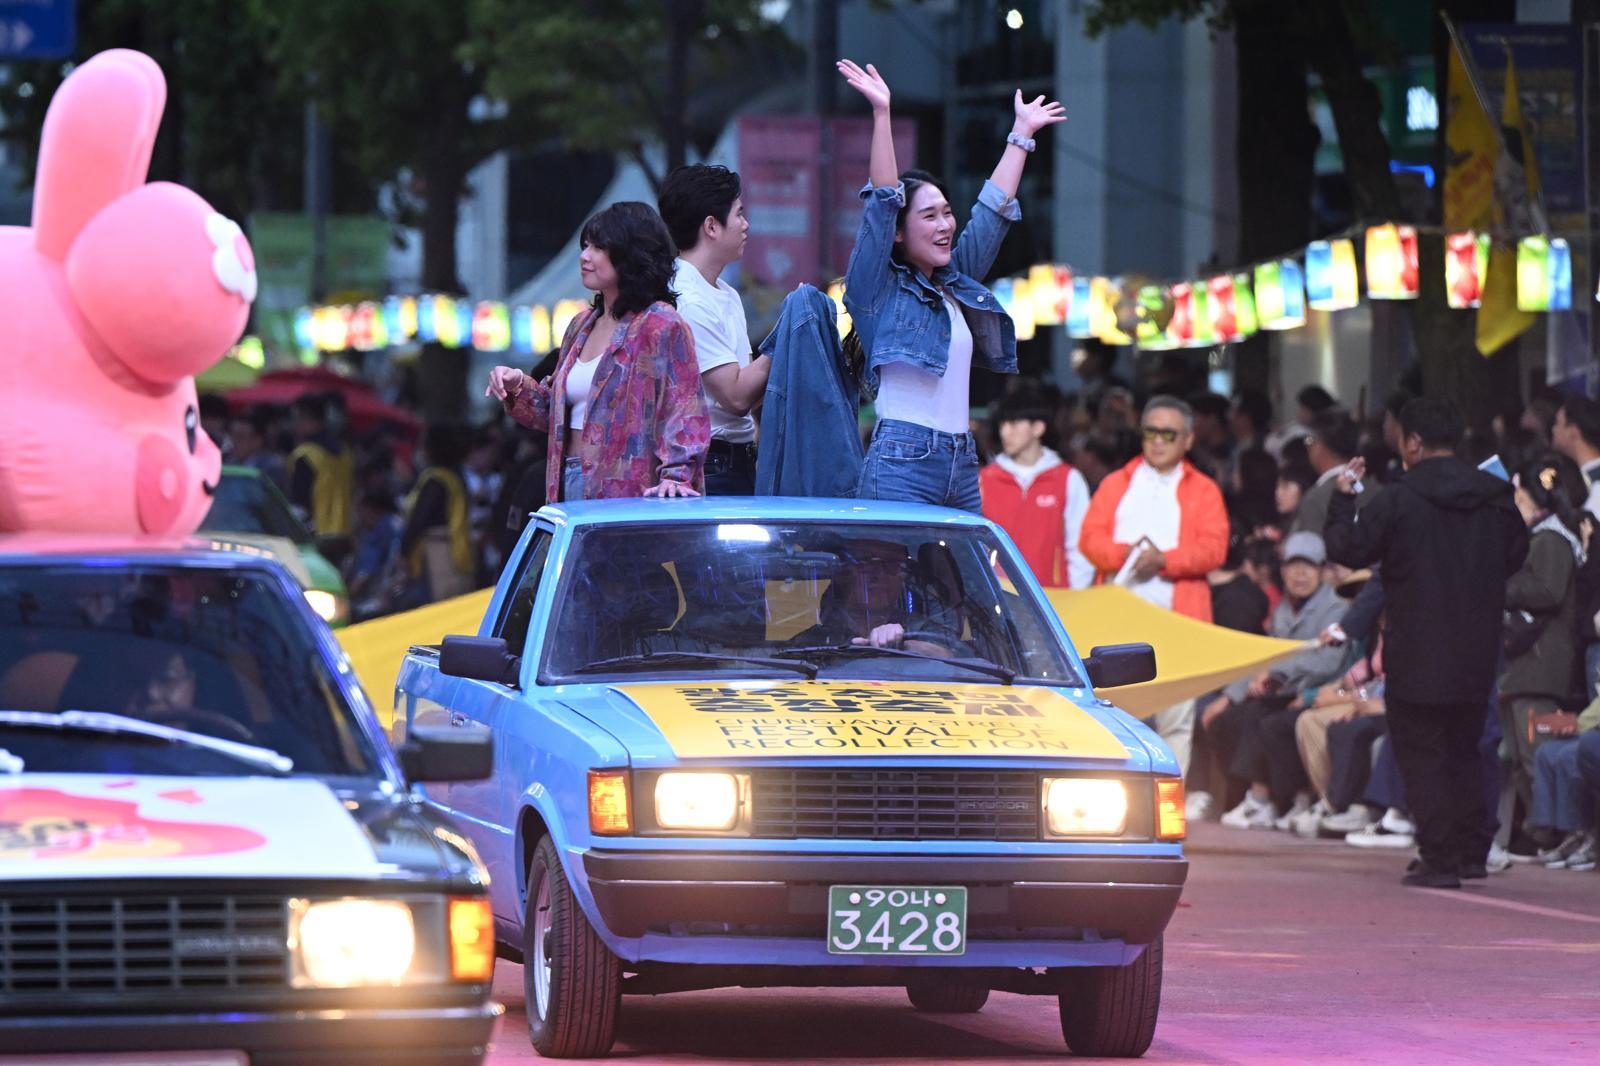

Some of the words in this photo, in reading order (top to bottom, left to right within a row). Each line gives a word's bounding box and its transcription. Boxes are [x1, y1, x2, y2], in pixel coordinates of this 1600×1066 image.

[826, 689, 1025, 703] 추억의
[685, 698, 1045, 717] 충장축제
[715, 718, 917, 726] CHUNGJANG
[719, 725, 970, 737] FESTIVAL
[987, 727, 1056, 739] OF
[727, 737, 1070, 750] RECOLLECTION
[865, 890, 931, 907] 90나
[832, 910, 962, 952] 3428
